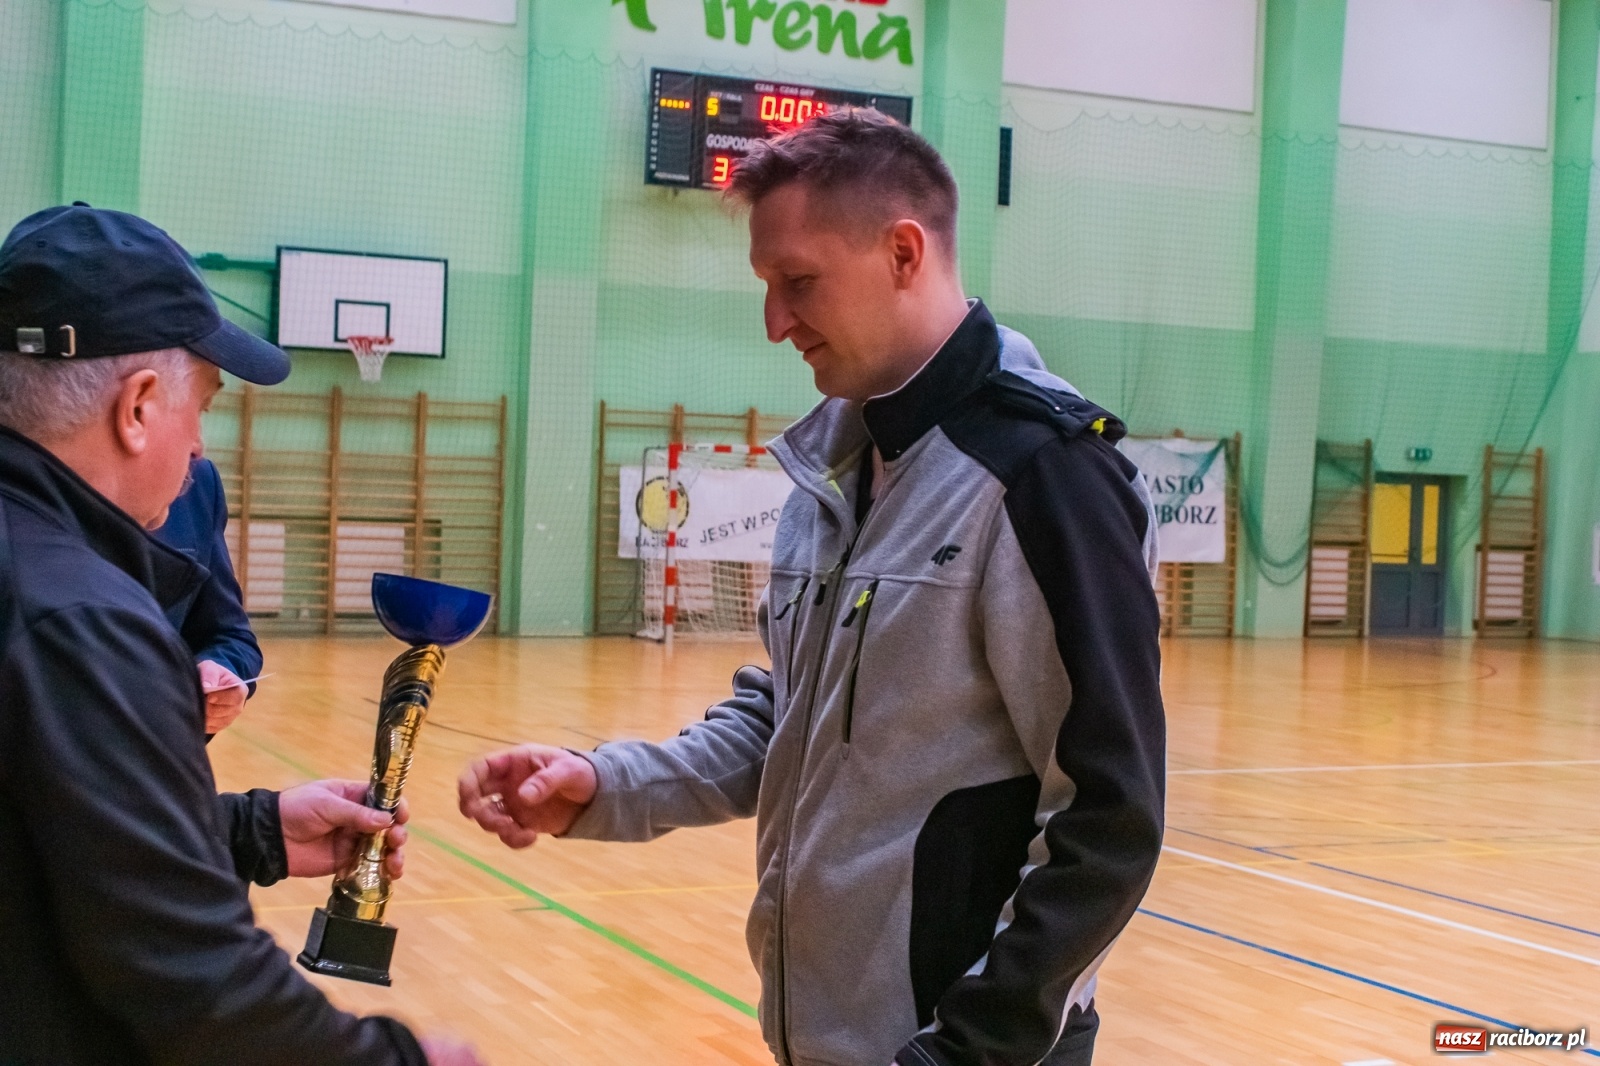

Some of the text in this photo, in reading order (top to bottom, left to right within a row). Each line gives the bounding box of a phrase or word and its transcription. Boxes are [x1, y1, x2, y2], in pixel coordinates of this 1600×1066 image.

[612, 0, 913, 65] rena
[707, 97, 719, 116] 5
[713, 157, 729, 182] 3
[700, 520, 736, 543] JEST
[741, 515, 756, 530] W
